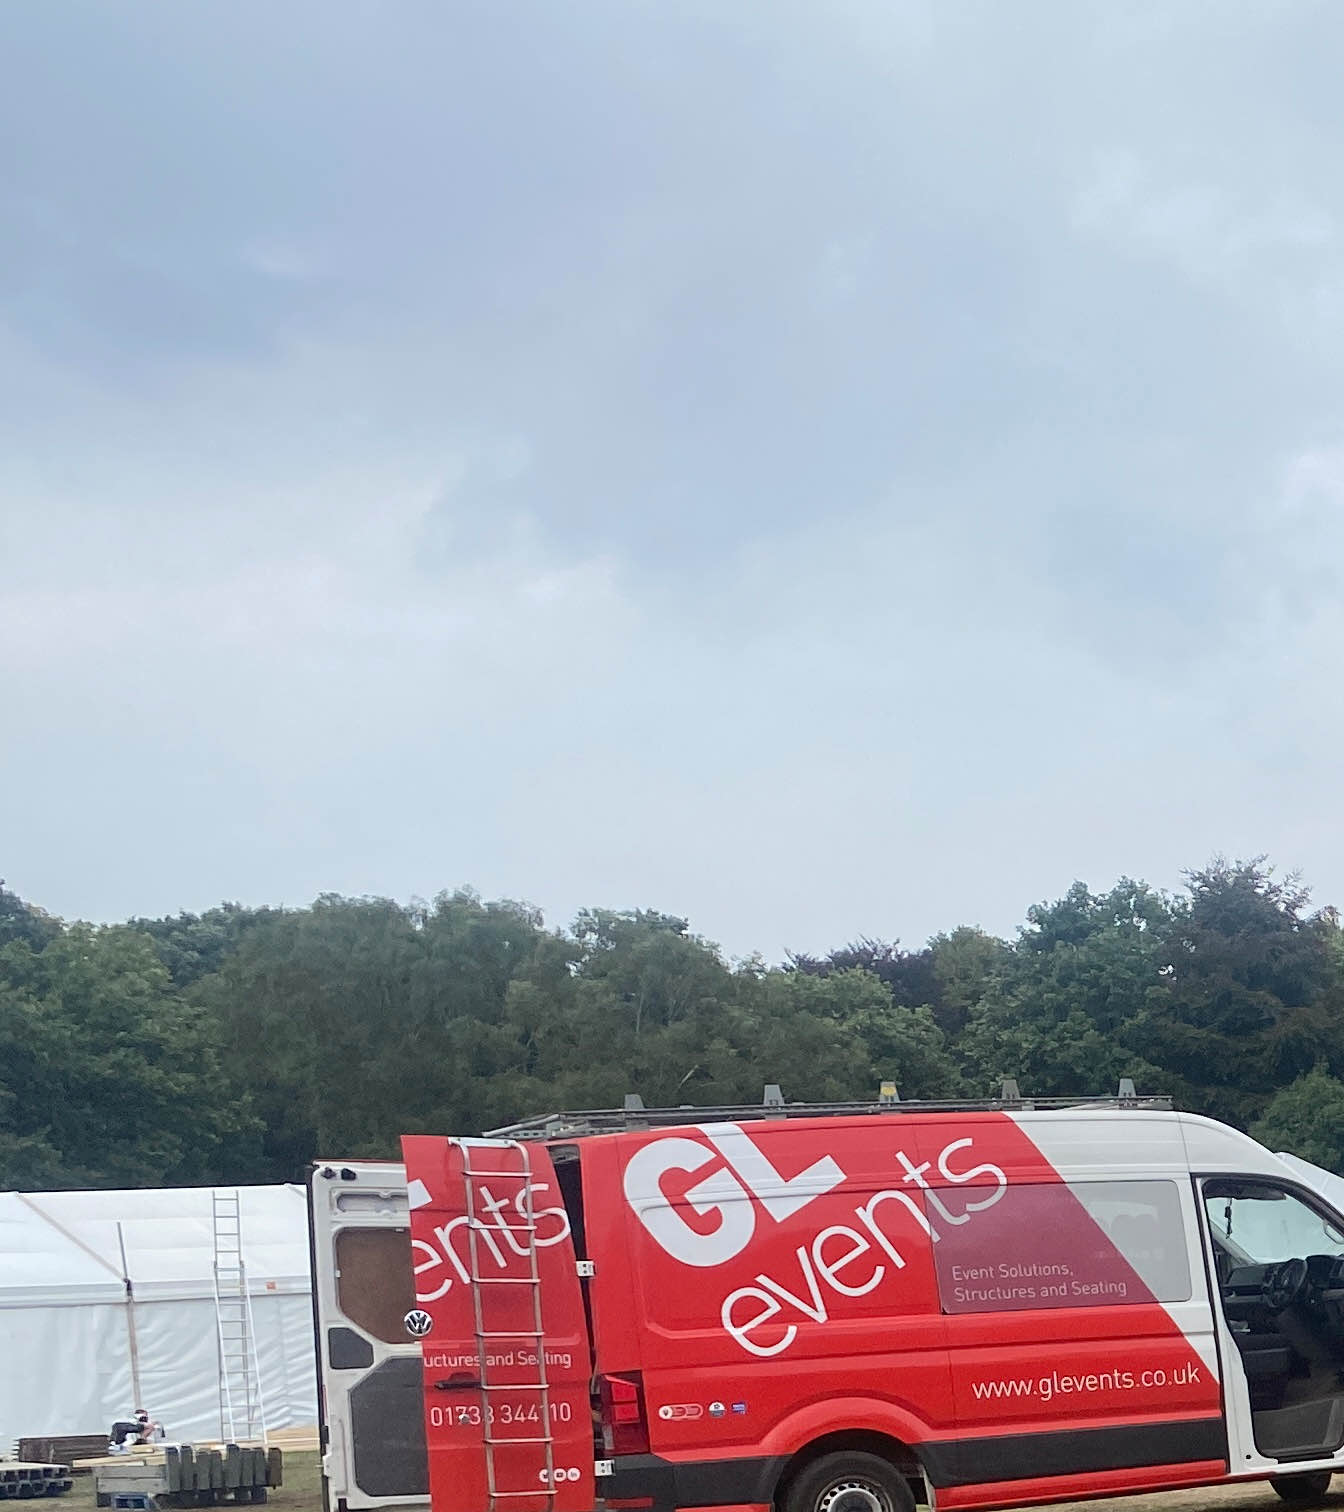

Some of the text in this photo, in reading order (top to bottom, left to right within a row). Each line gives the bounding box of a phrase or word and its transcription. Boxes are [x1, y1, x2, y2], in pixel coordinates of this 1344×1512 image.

[623, 1123, 847, 1267] GL
[721, 1138, 1008, 1357] events
[952, 1263, 1074, 1281] Event Solutions,
[954, 1279, 1127, 1302] Structures and Seating
[486, 1351, 514, 1366] and
[517, 1350, 572, 1369] Seting
[971, 1361, 1201, 1401] www.glevents.co.uk
